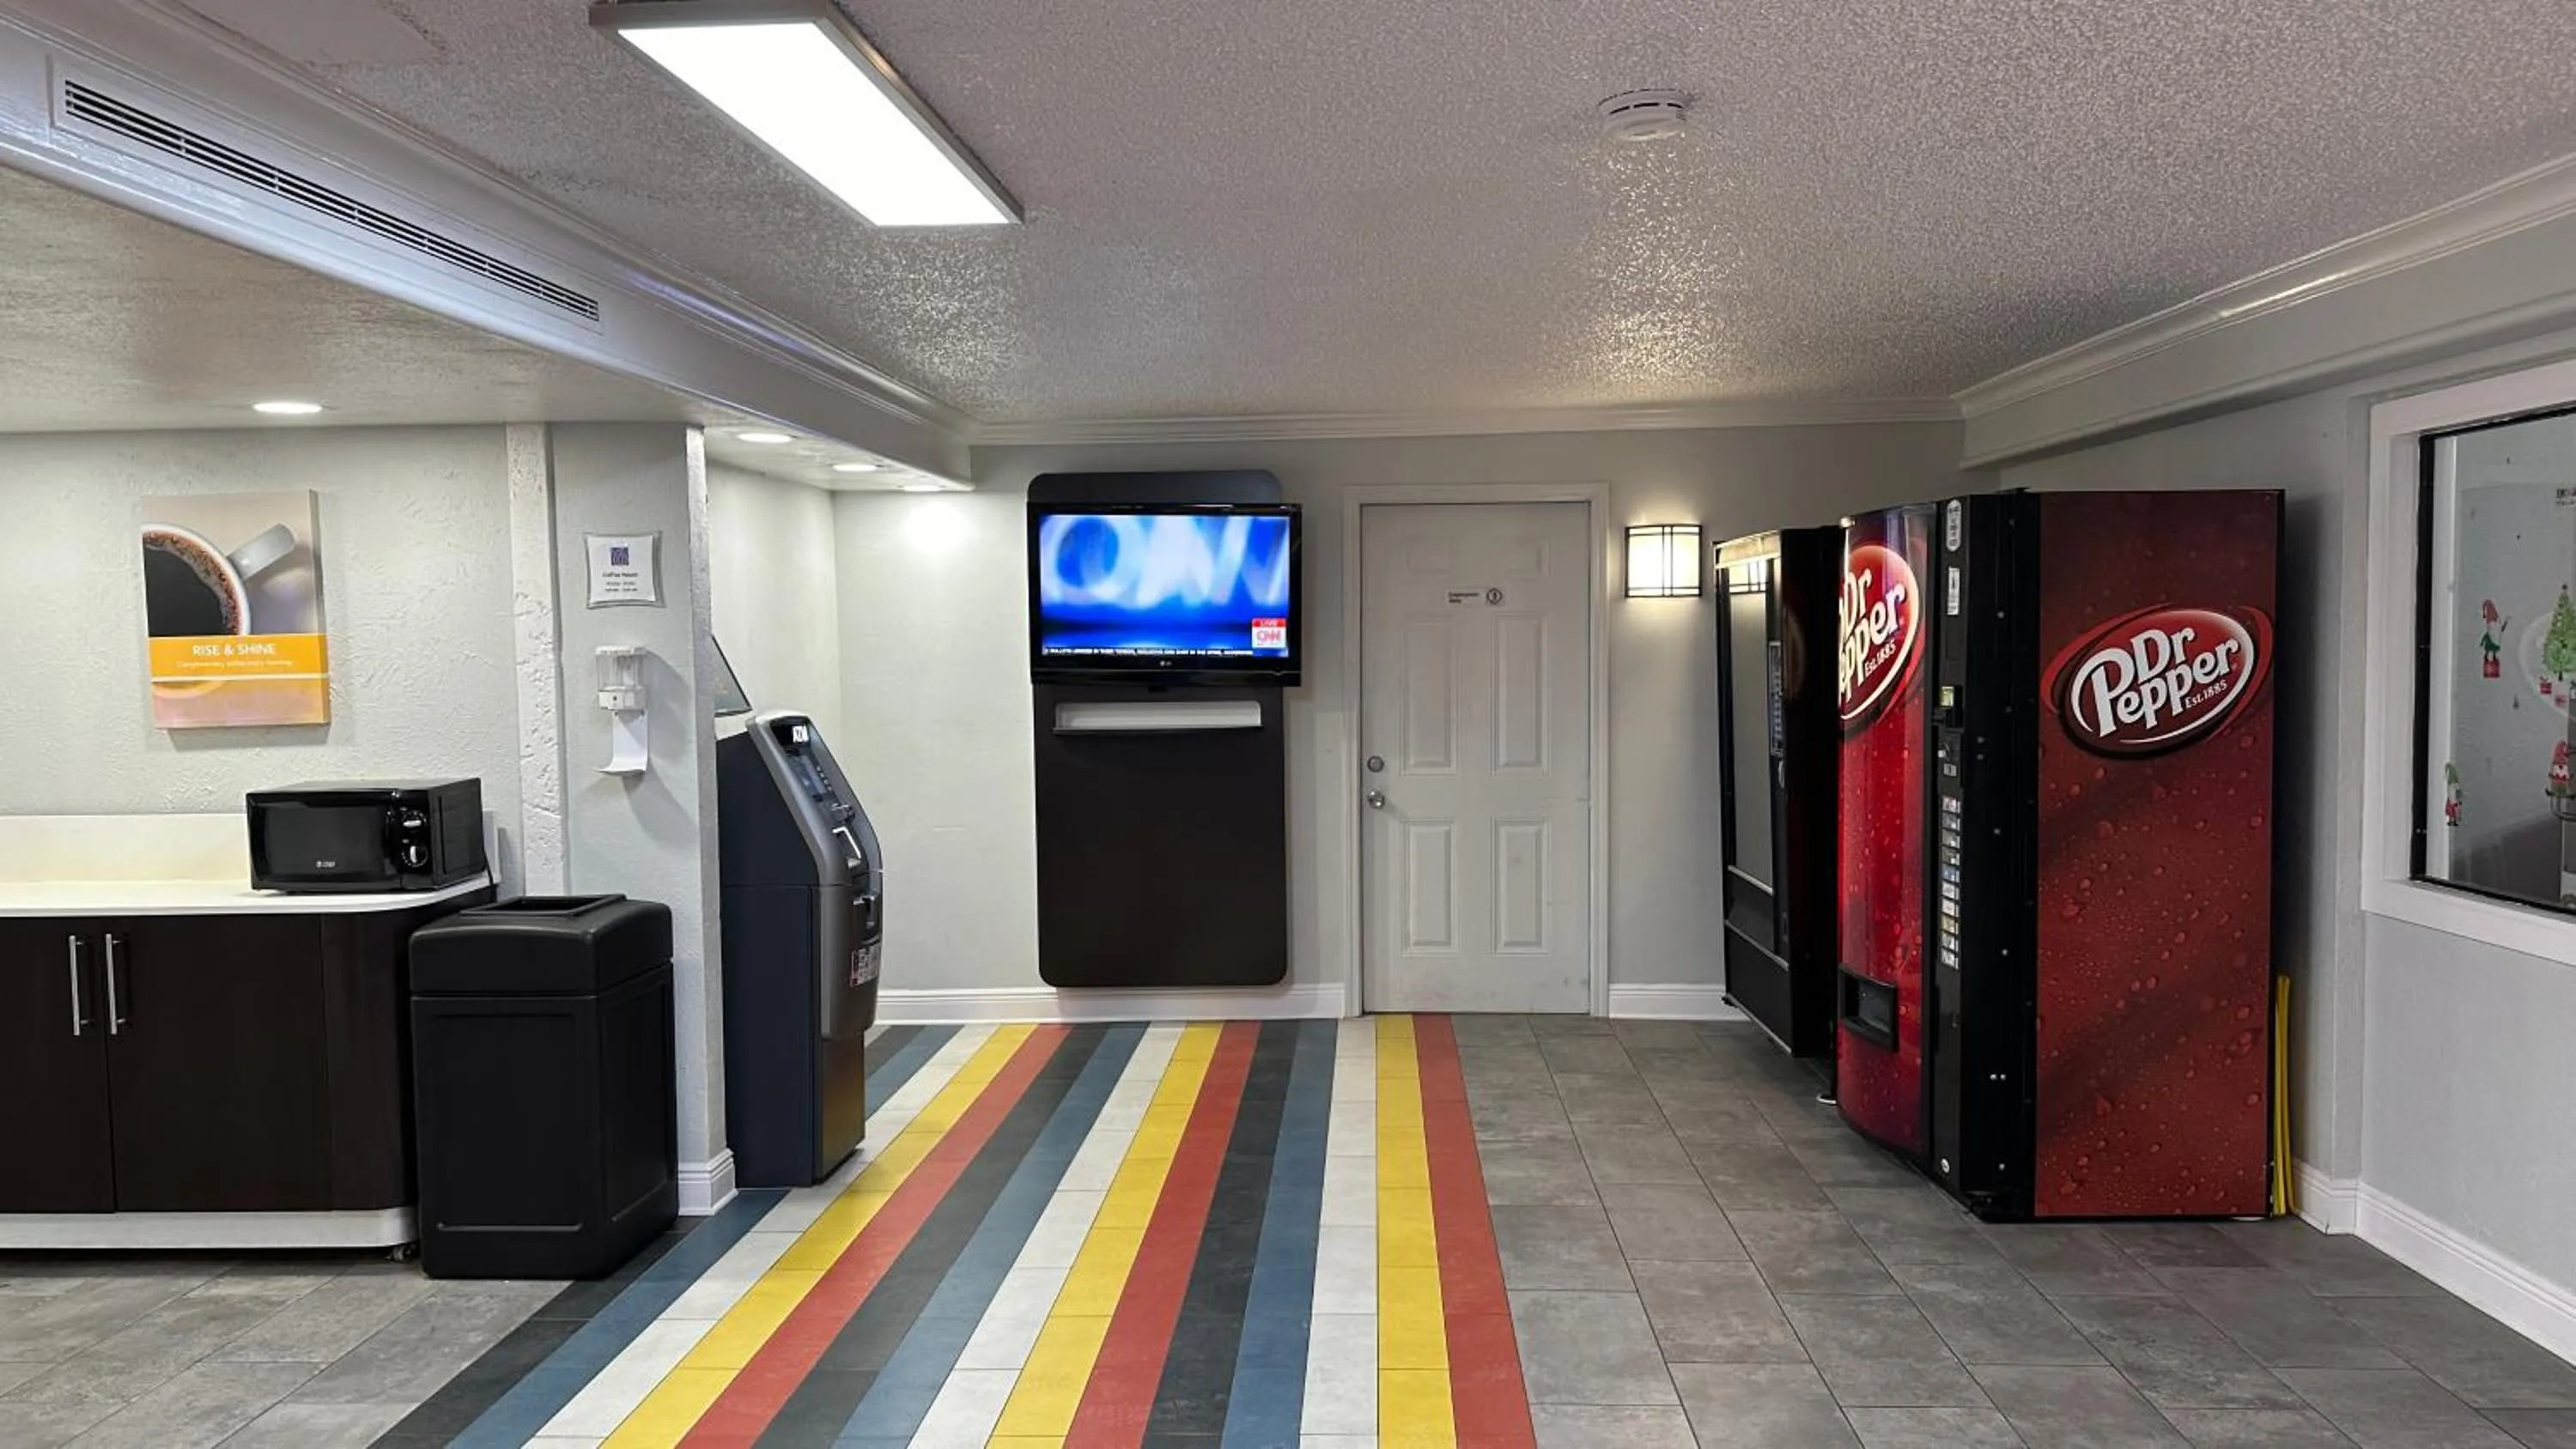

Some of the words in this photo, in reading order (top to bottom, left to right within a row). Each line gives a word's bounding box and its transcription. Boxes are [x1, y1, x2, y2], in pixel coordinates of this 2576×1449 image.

[192, 645, 221, 656] RISE
[223, 644, 234, 656] &
[238, 643, 277, 656] SHINE
[2130, 627, 2195, 685] Dr
[2071, 639, 2239, 737] Pepper
